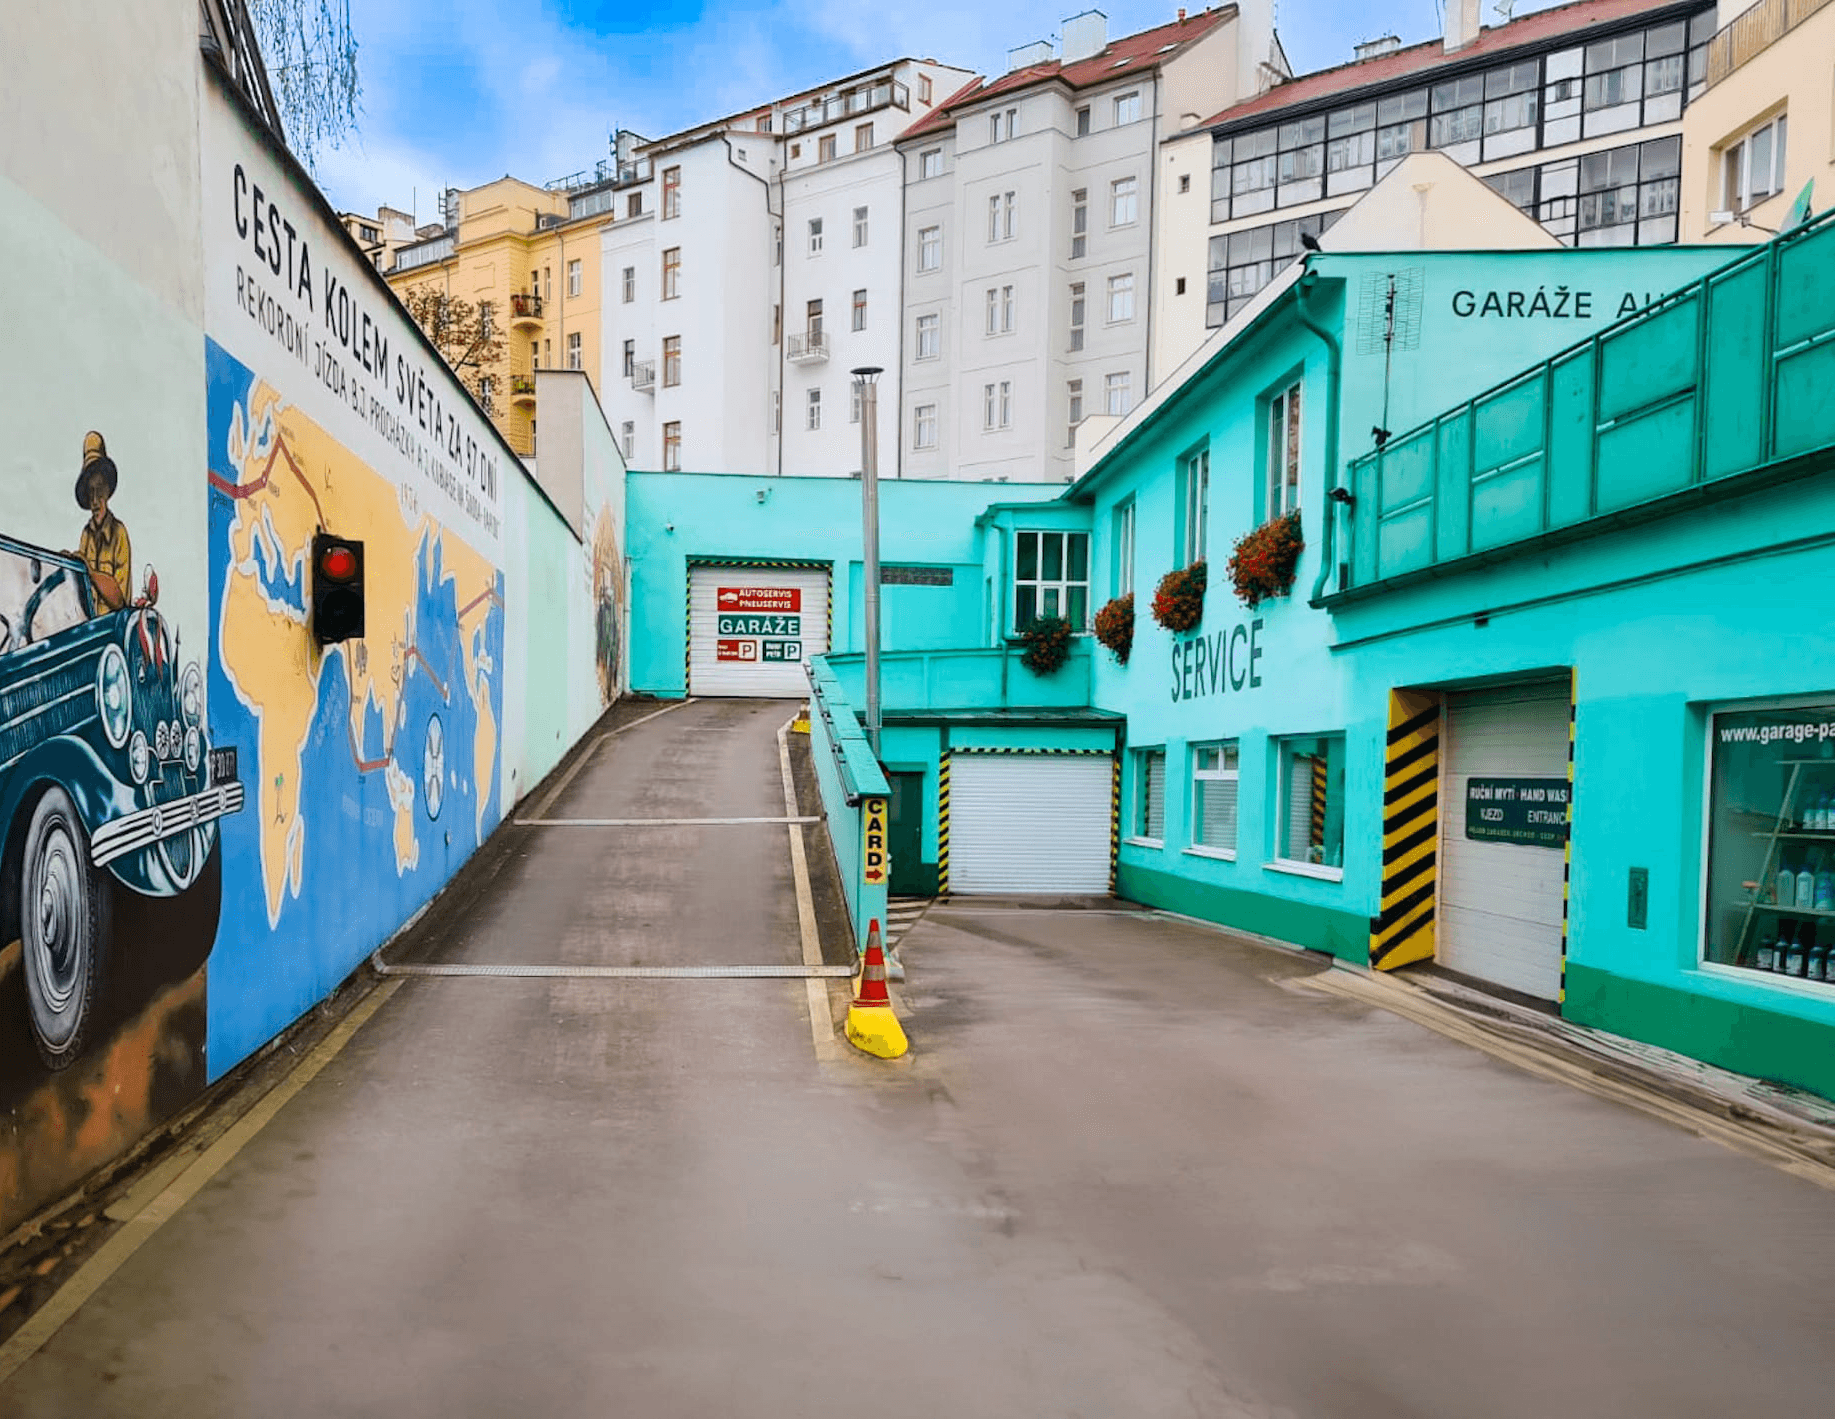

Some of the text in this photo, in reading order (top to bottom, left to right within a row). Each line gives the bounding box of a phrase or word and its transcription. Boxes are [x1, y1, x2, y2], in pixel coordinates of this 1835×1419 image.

[1452, 285, 1592, 318] GARÁŽE
[233, 163, 313, 313] CESTA
[325, 267, 388, 389] KOLEM
[396, 354, 443, 448] SVĚTA
[448, 413, 463, 468] ZA
[480, 452, 497, 504] DNÍ
[236, 264, 309, 367] REKORDNÍ
[314, 340, 348, 403] JÍZDA
[739, 589, 792, 598] AUTOSERVIS
[720, 616, 798, 635] GARÁŽE
[742, 644, 752, 657] P
[787, 645, 797, 657] P
[1171, 619, 1264, 703] SERVICE
[1520, 788, 1545, 801] HAND
[867, 799, 883, 867] CARD
